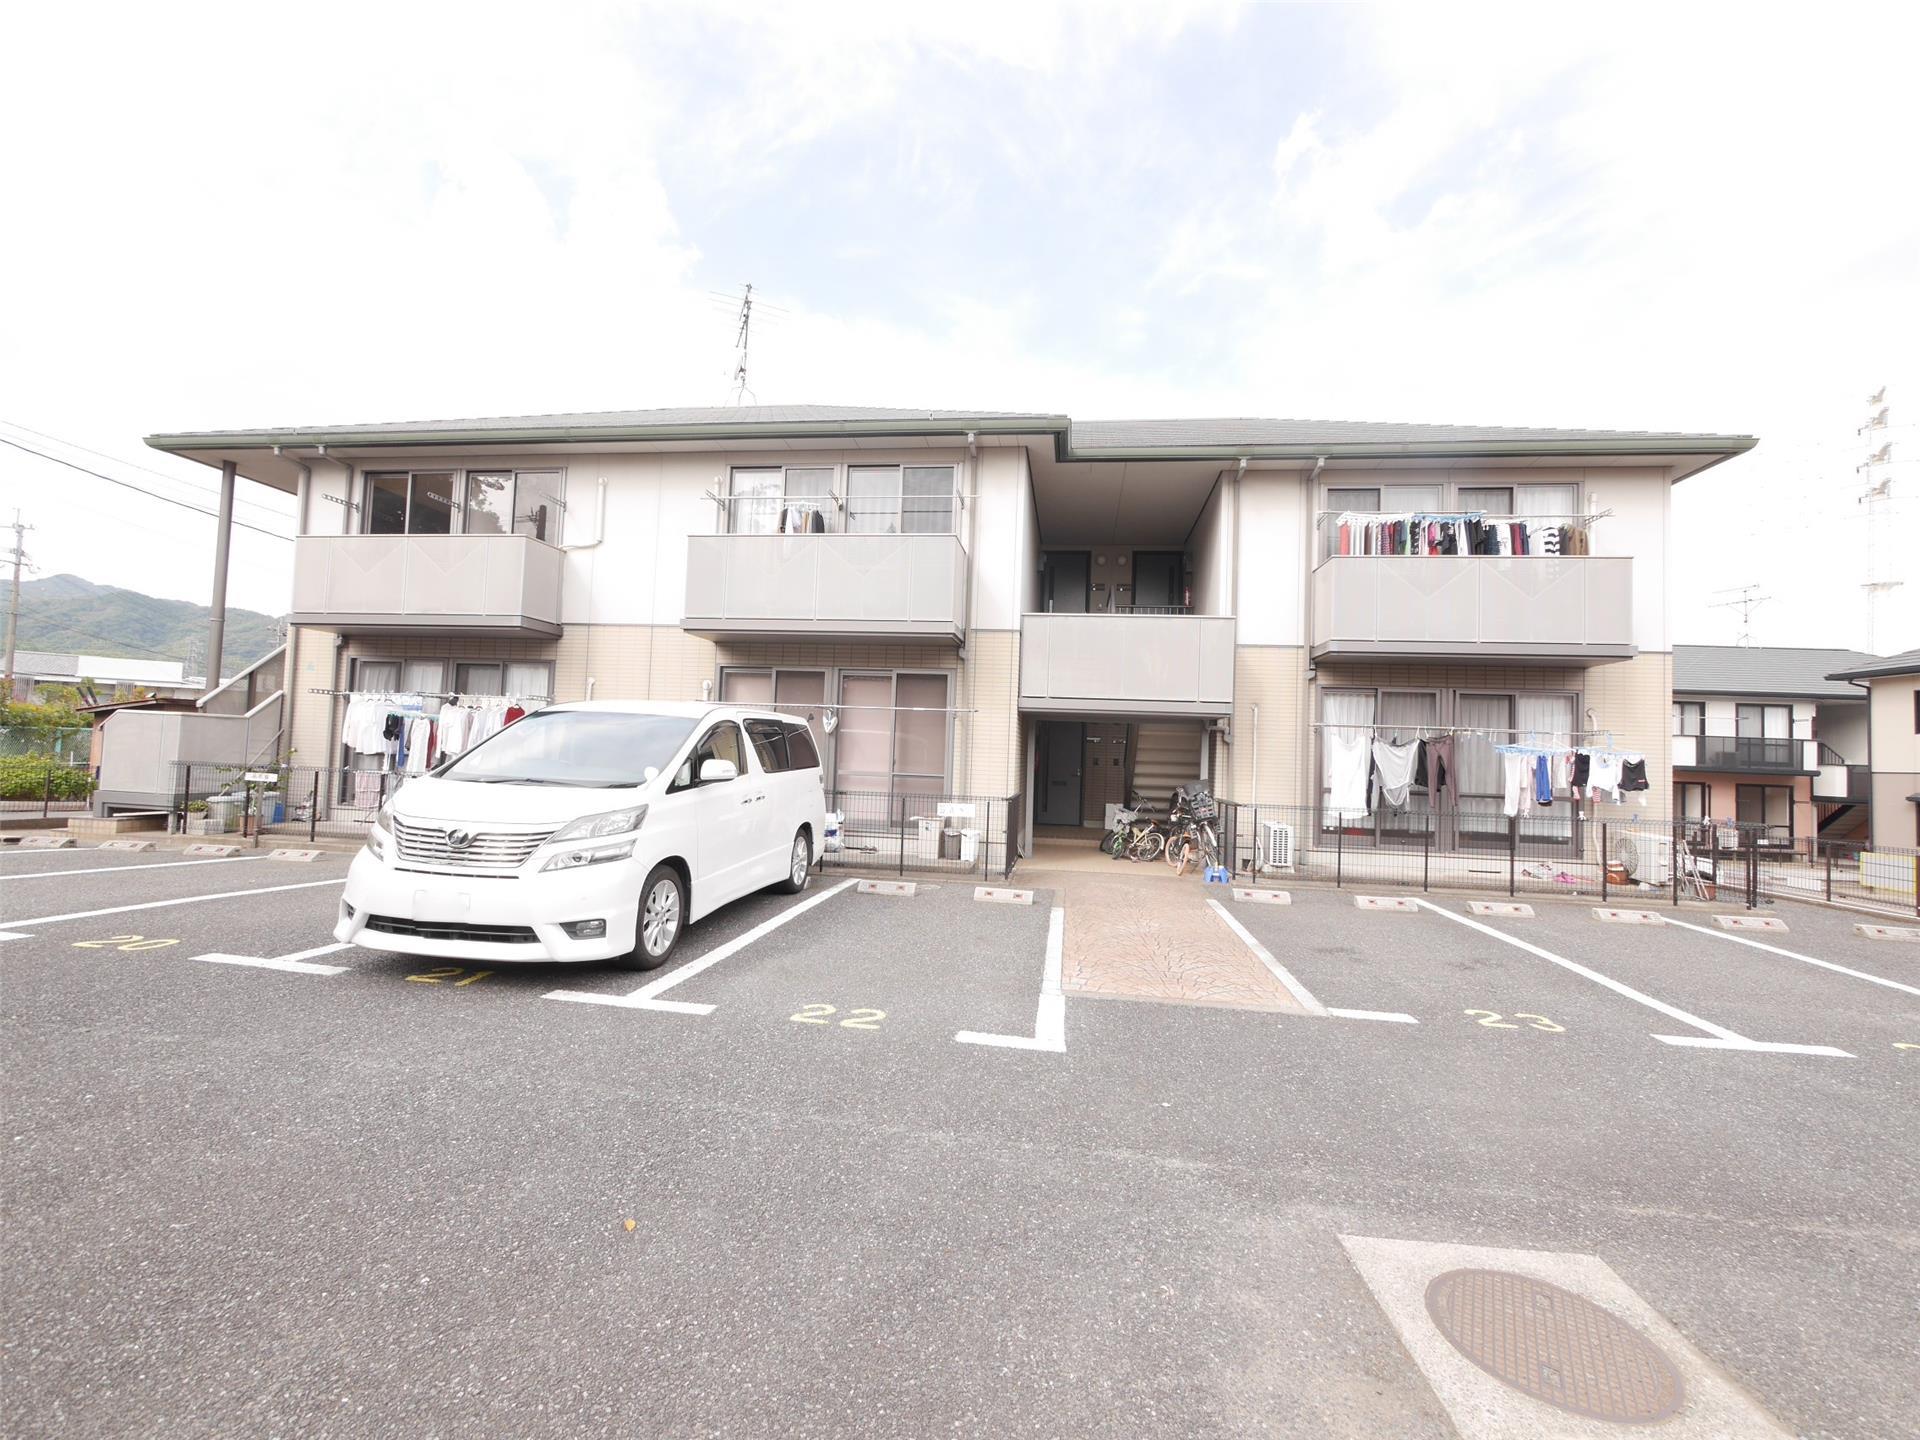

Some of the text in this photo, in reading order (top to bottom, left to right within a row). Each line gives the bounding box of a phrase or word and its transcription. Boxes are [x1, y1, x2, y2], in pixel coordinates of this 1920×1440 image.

[71, 935, 180, 950] 20
[405, 967, 495, 987] 21
[790, 1003, 886, 1029] 22
[1464, 1009, 1566, 1032] 23
